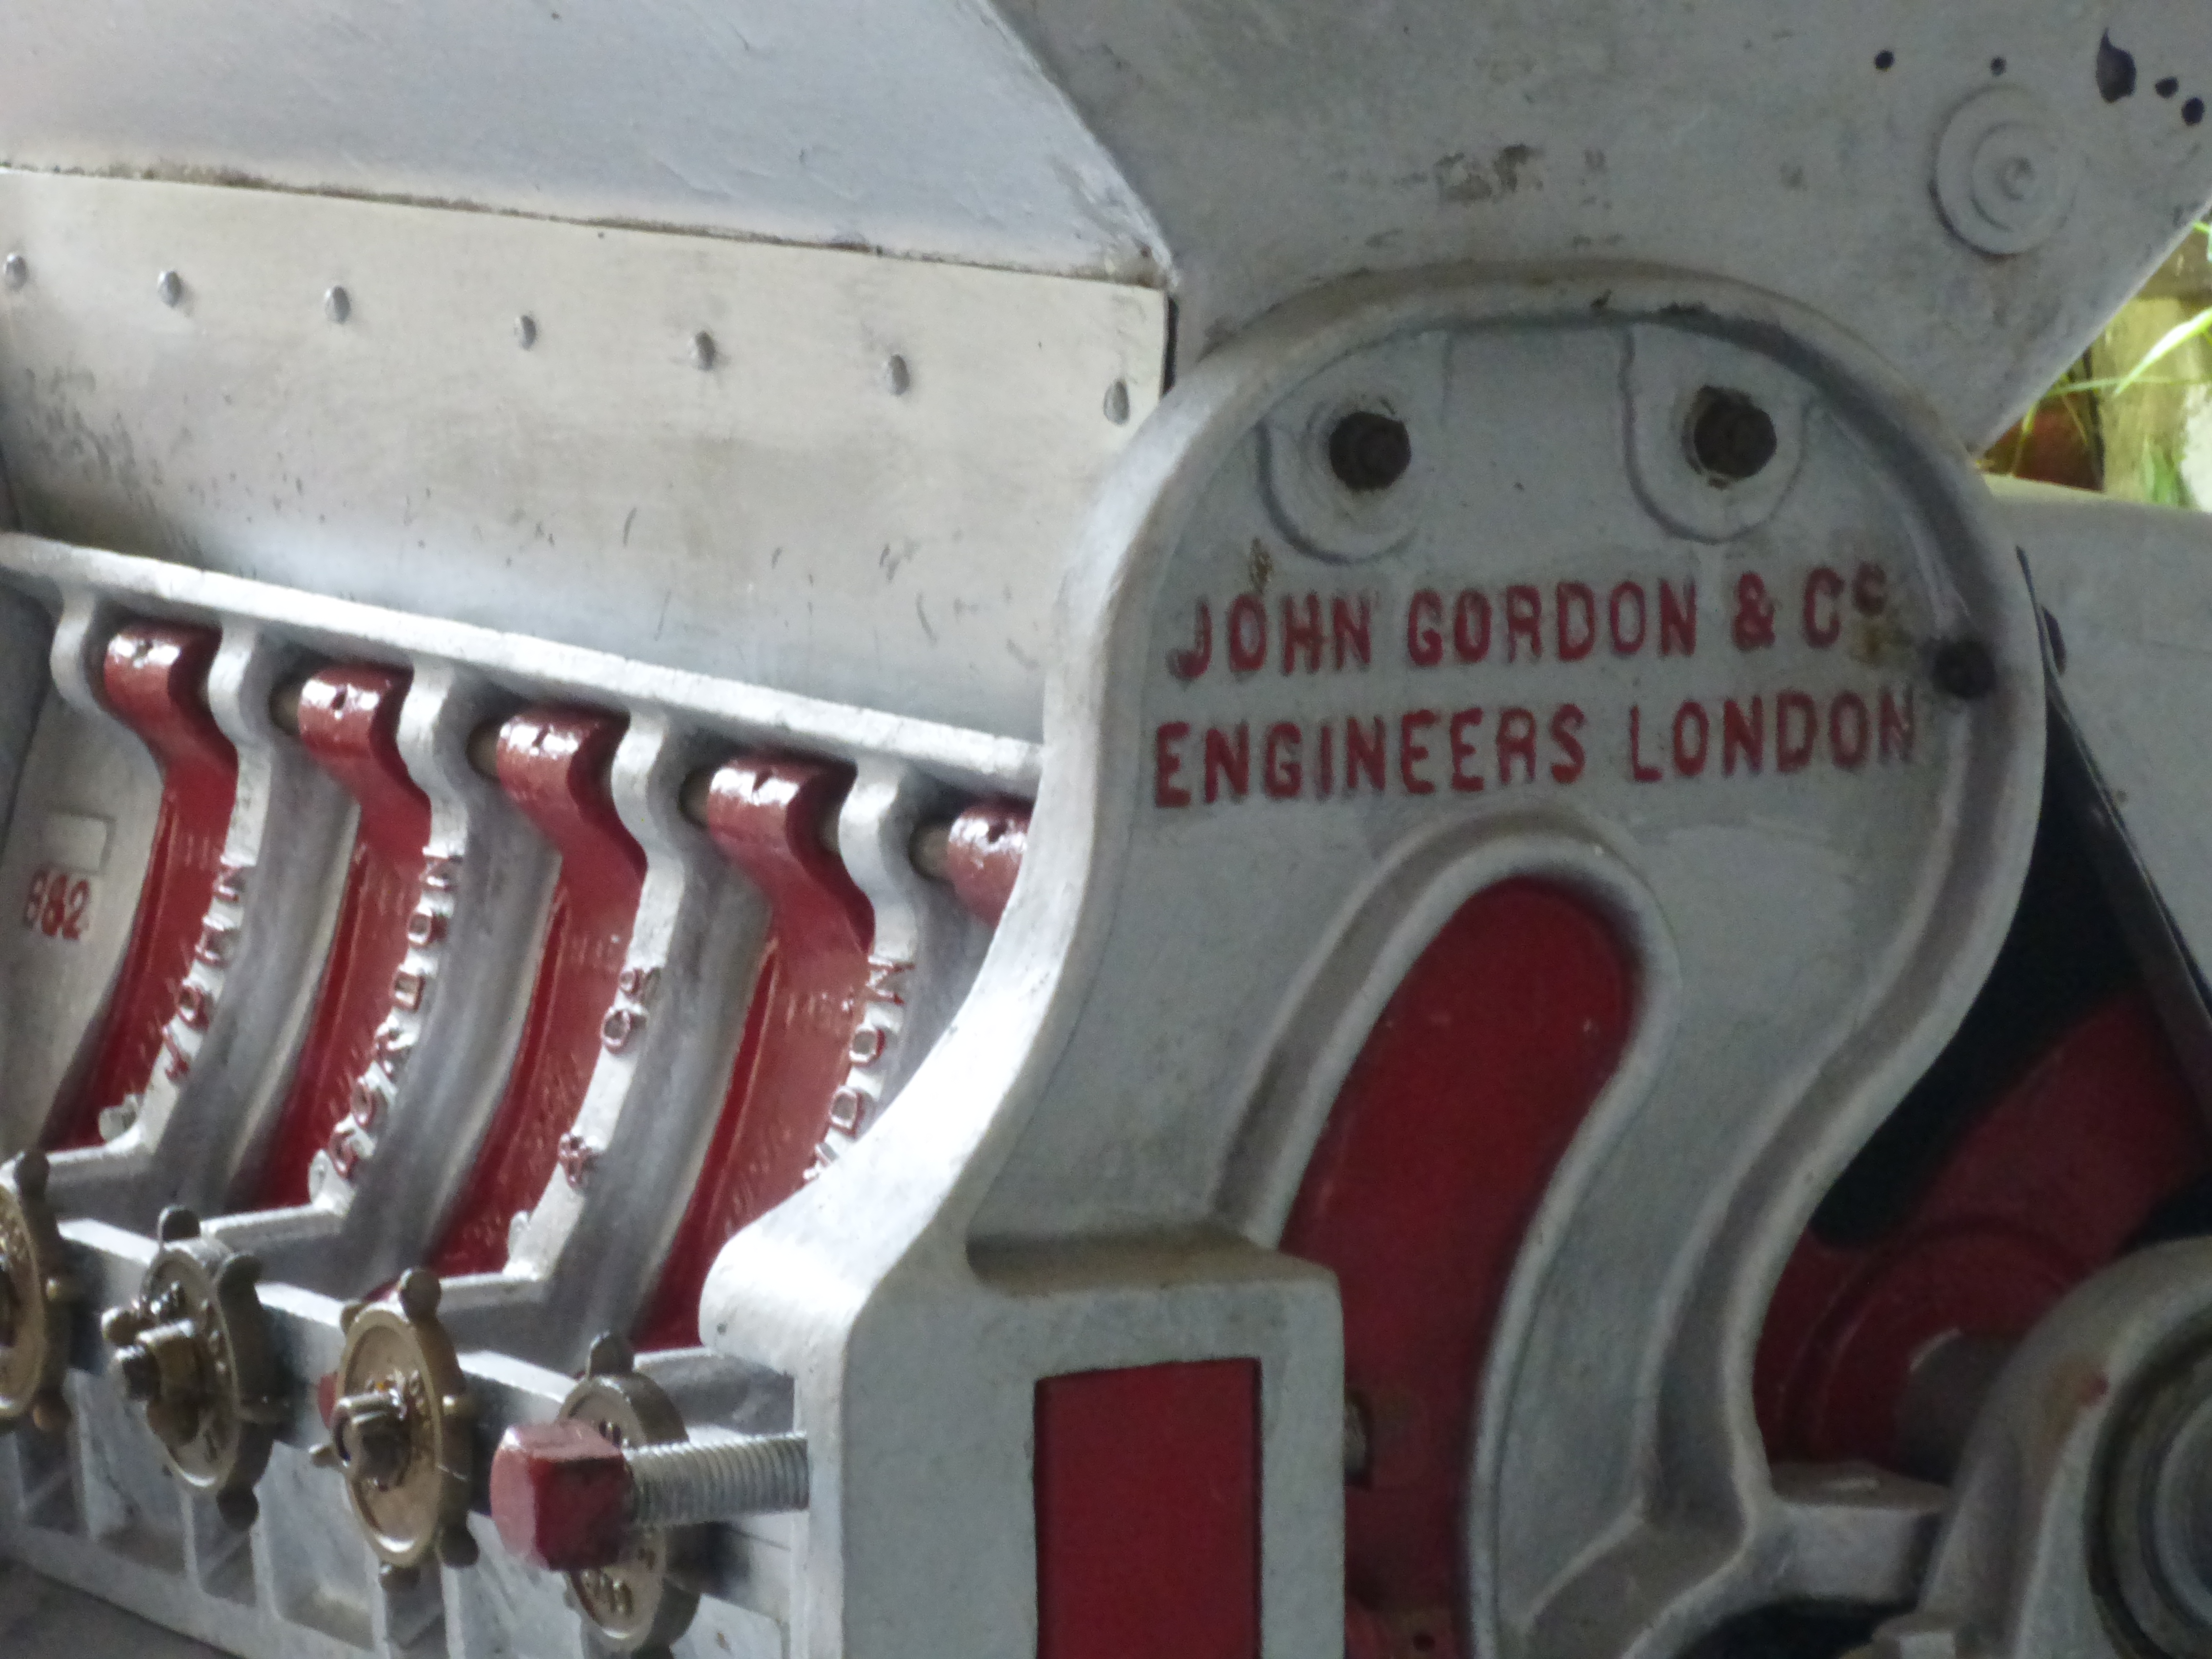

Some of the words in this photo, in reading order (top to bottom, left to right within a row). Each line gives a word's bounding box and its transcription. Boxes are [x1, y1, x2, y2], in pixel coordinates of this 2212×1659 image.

[1166, 586, 1374, 681] JOHN
[1405, 576, 1698, 668] GORDON
[1730, 571, 1777, 651] &
[1154, 703, 1587, 808] ENGINEERS
[1627, 683, 1915, 783] LONDON
